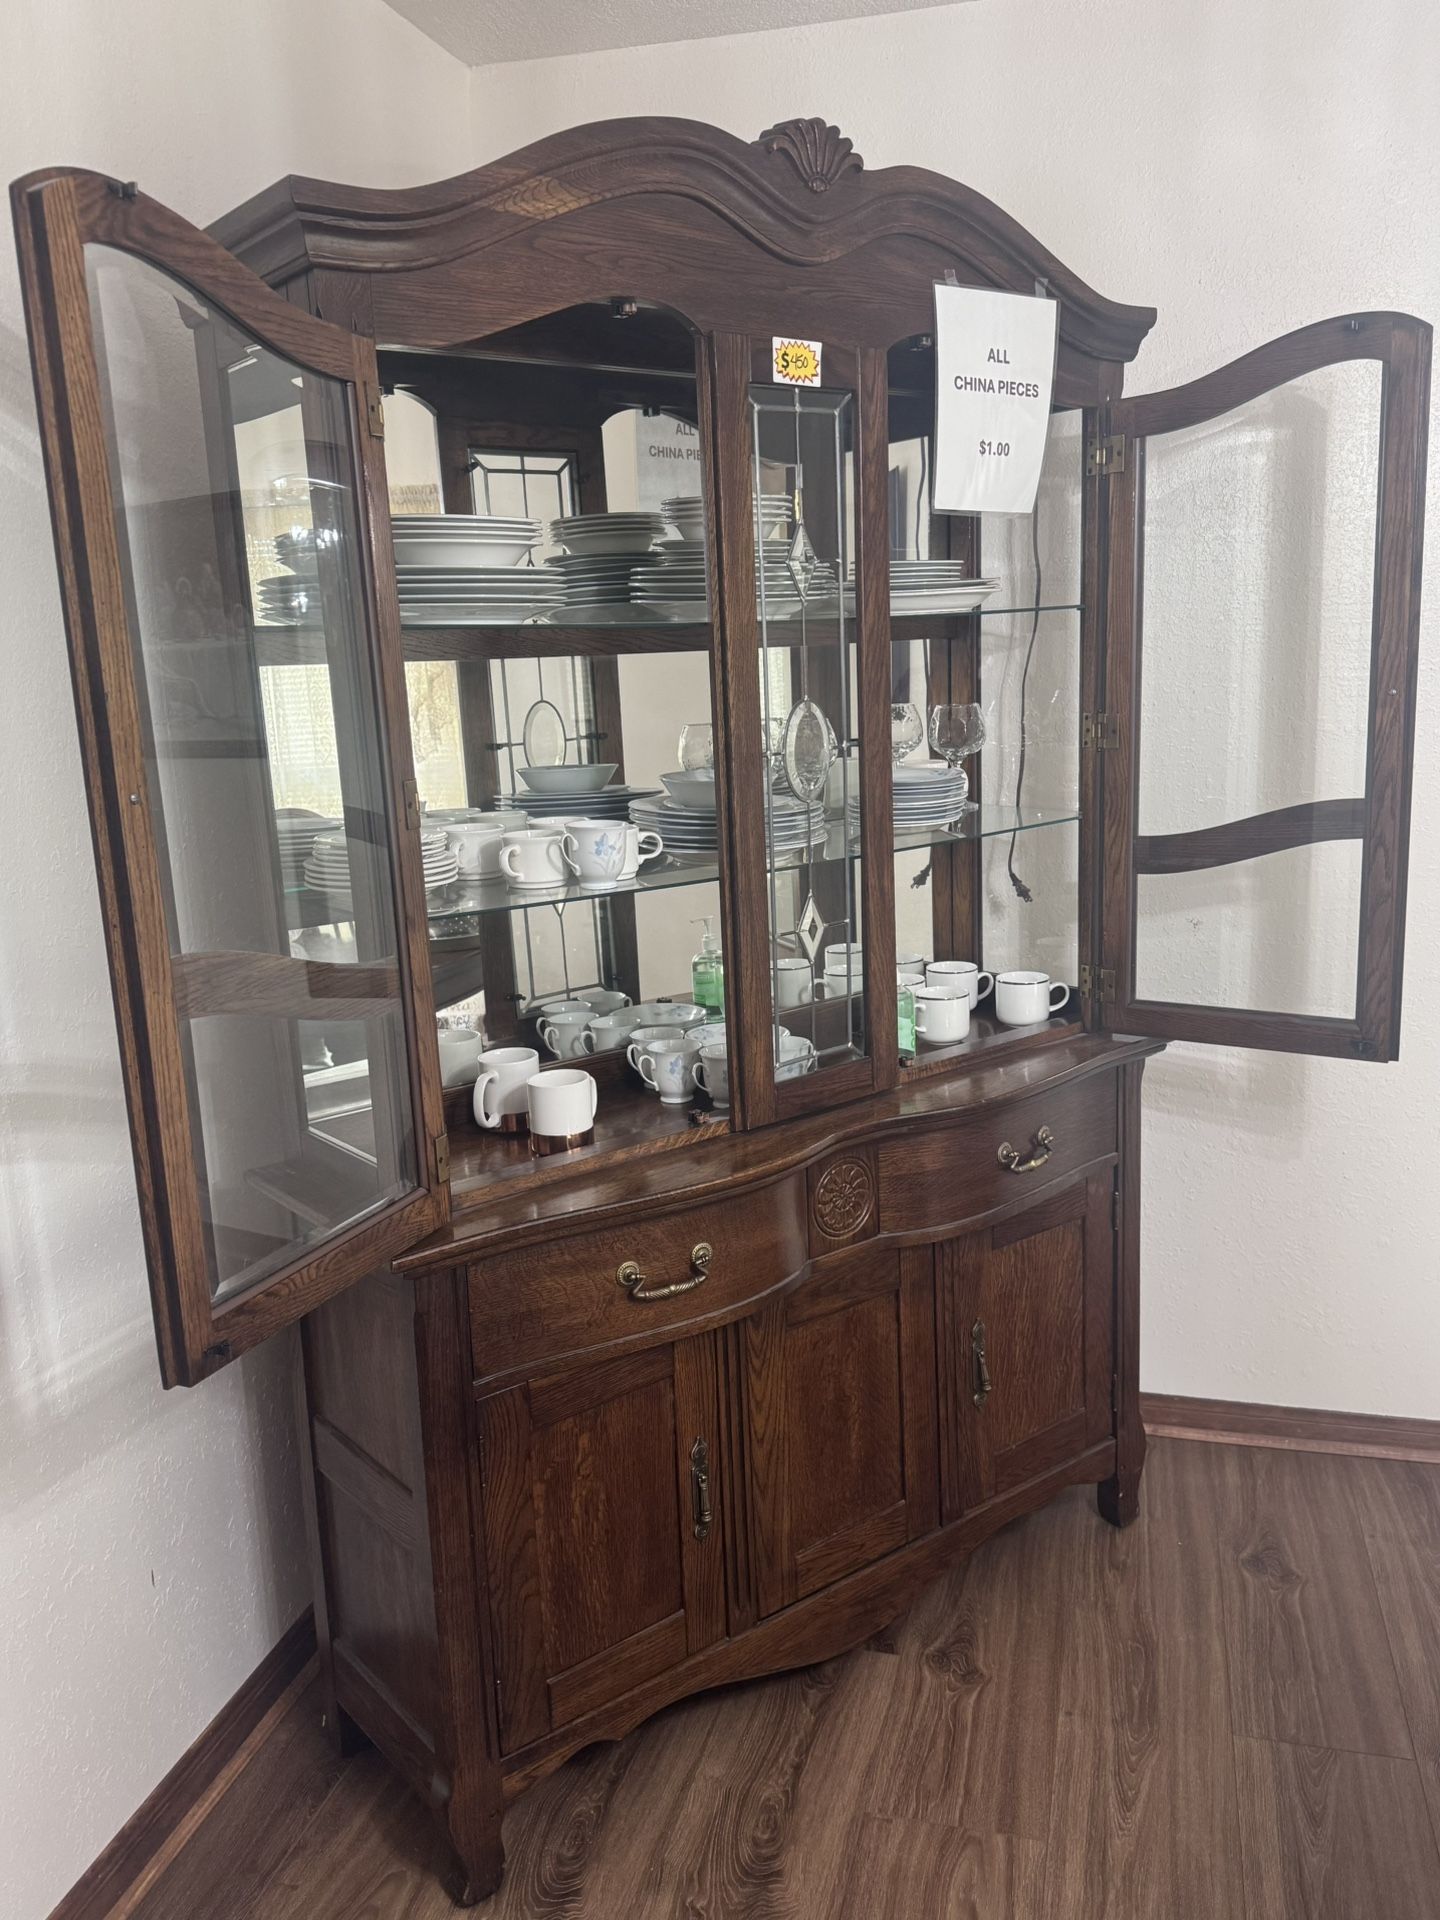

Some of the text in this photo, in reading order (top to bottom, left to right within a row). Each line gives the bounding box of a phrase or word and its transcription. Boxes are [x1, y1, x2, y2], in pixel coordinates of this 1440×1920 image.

[781, 350, 809, 371] $450
[987, 348, 1010, 364] ALL
[954, 376, 1039, 398] CHINA PIECES
[676, 423, 696, 436] ALL
[649, 445, 701, 461] CHINA PIE
[979, 439, 1010, 457] $1.00
